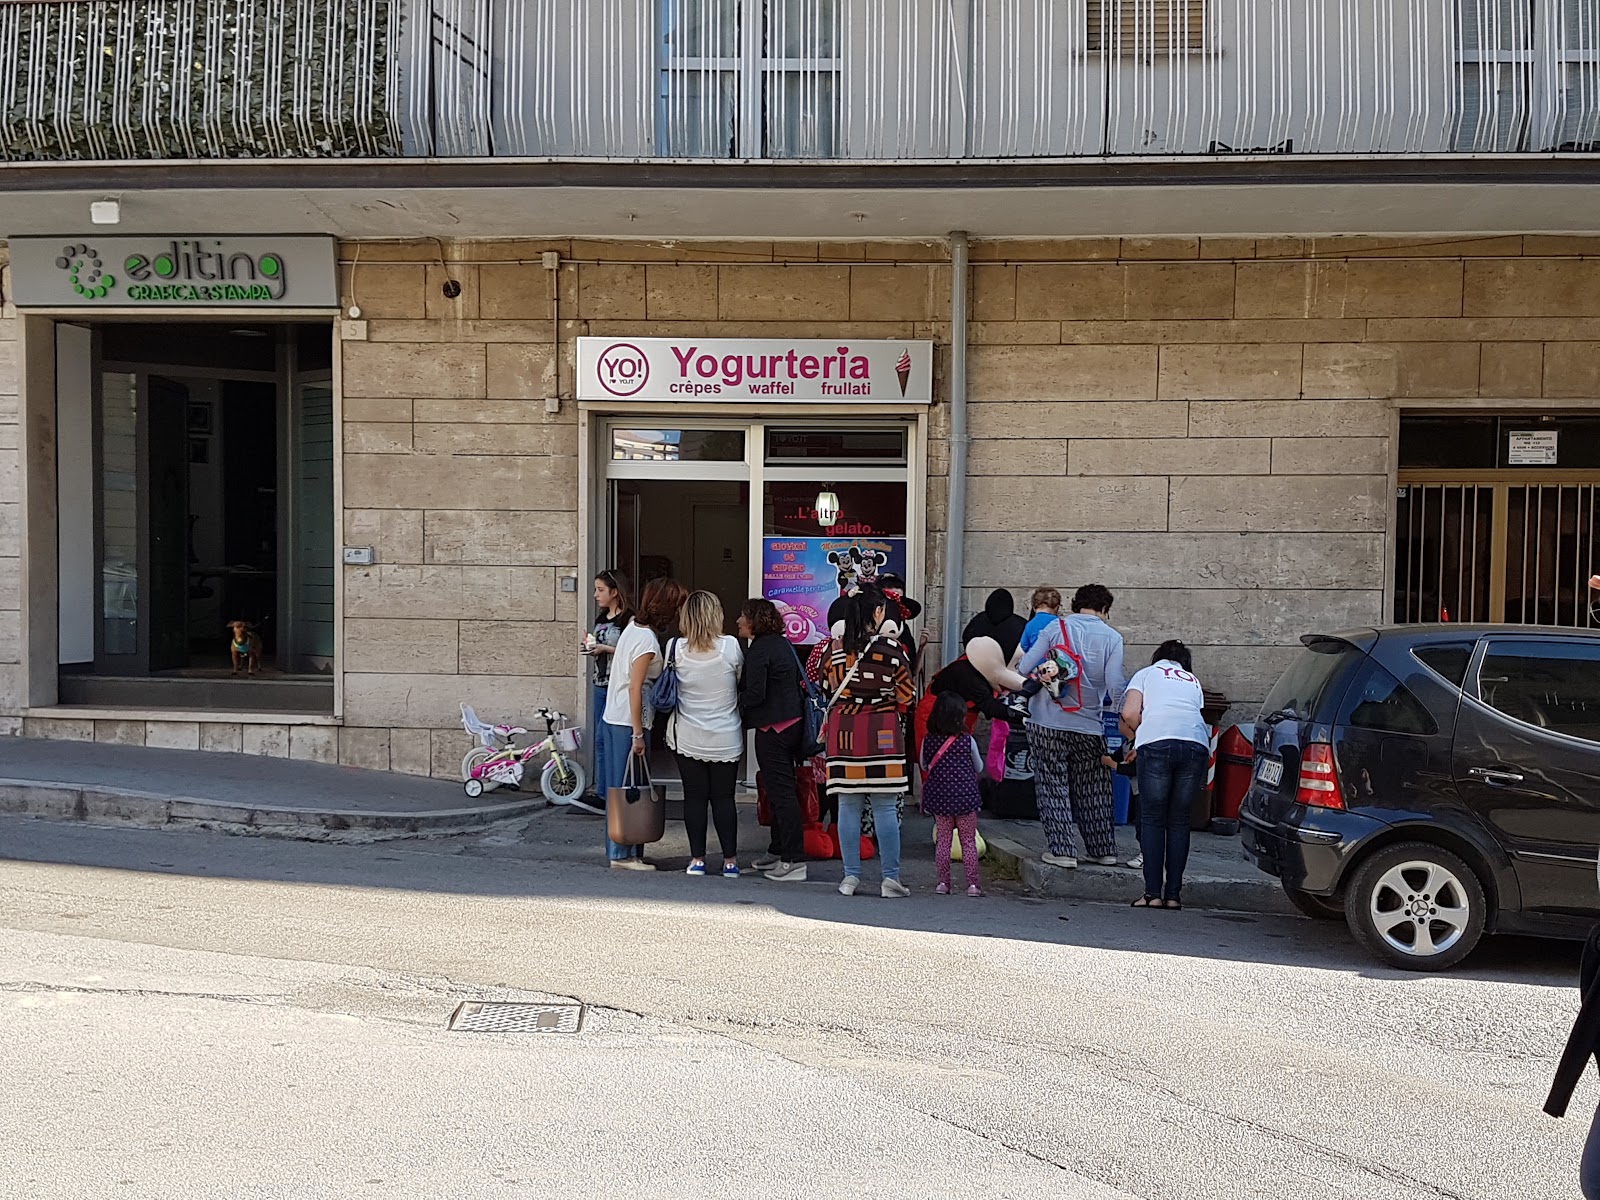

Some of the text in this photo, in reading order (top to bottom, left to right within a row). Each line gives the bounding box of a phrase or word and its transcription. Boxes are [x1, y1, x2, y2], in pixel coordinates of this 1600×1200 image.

[124, 241, 287, 299] editing
[604, 358, 642, 378] YO!
[670, 346, 870, 386] Yogurteria
[669, 381, 871, 396] crêpes waffel frullati
[825, 522, 886, 536] gelato...
